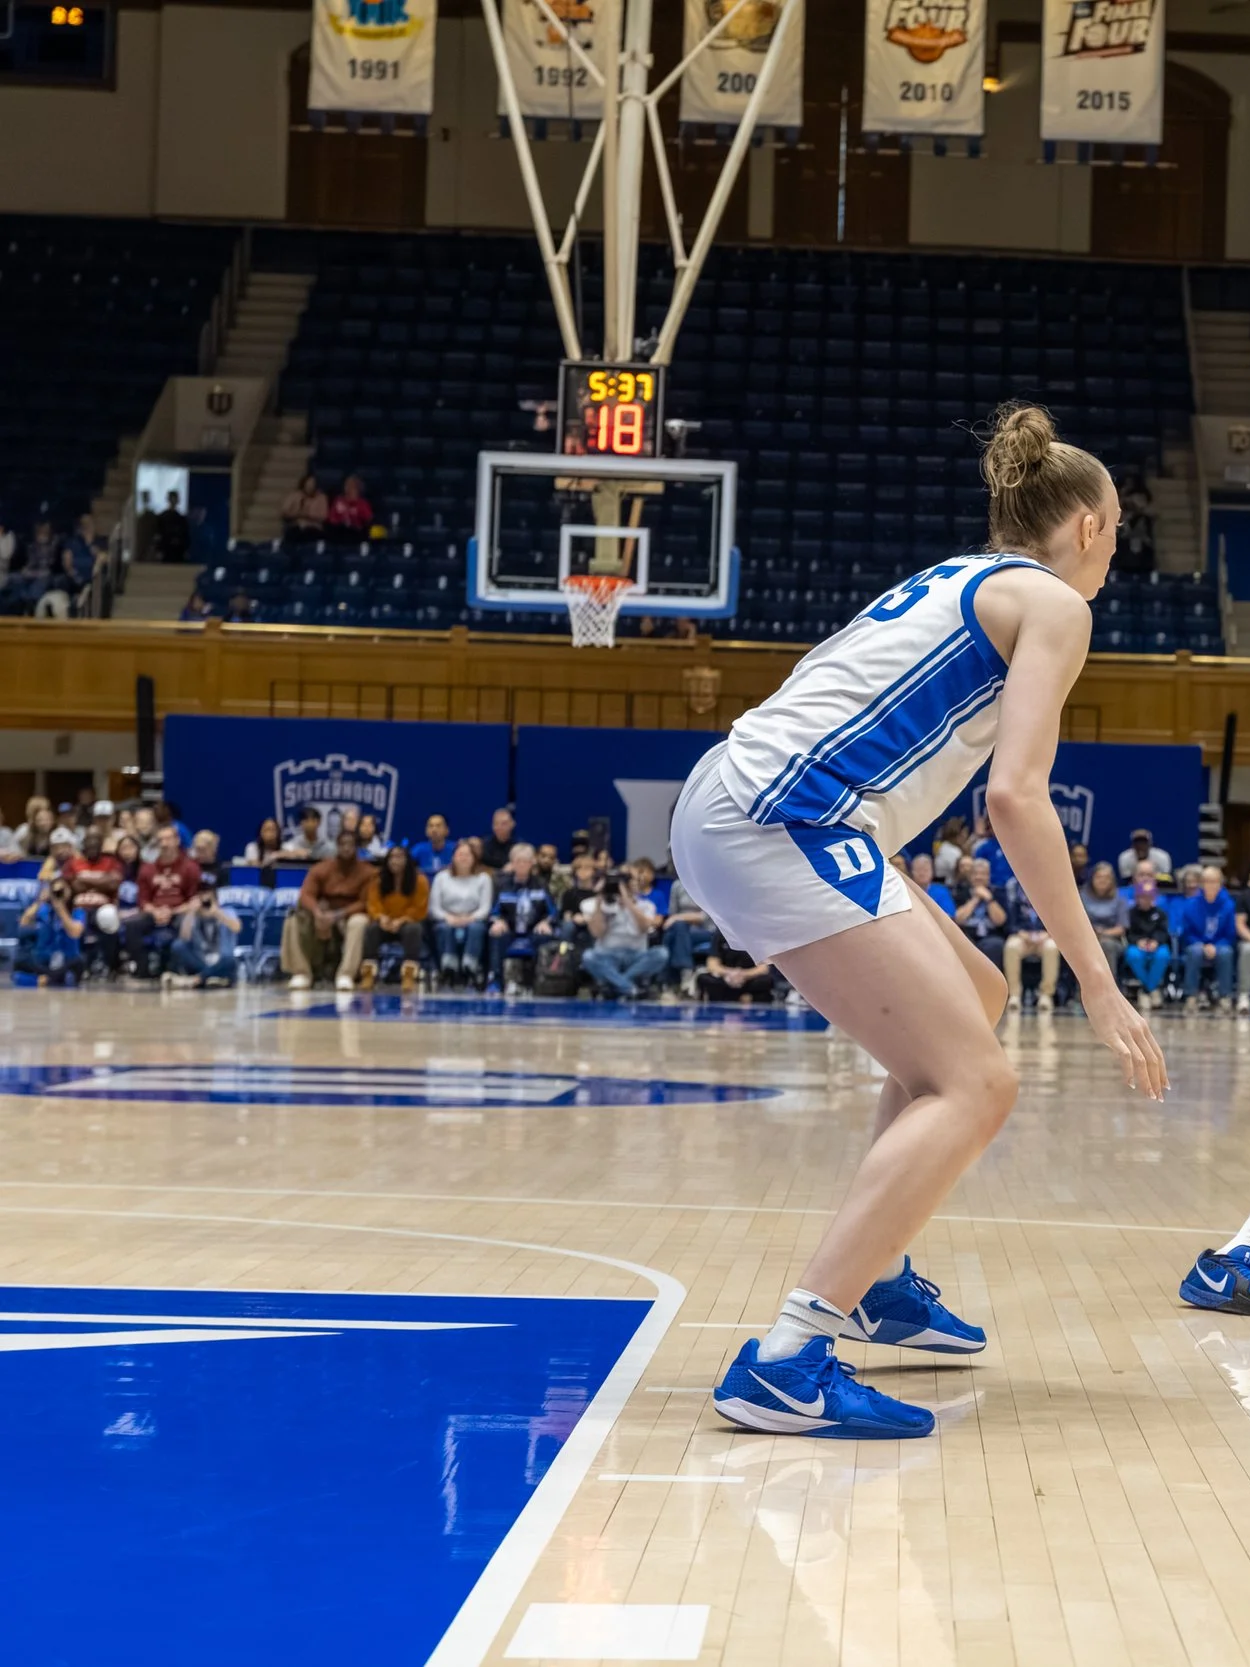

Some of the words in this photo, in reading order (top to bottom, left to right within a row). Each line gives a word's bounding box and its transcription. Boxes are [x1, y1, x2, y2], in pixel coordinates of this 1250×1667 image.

[348, 58, 400, 80] 1991
[535, 65, 588, 87] 1992
[717, 71, 759, 94] 200
[900, 81, 953, 102] 2010
[1077, 89, 1131, 110] 2015
[588, 371, 653, 402] 5:37
[597, 404, 643, 454] 18
[284, 779, 387, 811] SISTERHOOD
[823, 837, 876, 881] D
